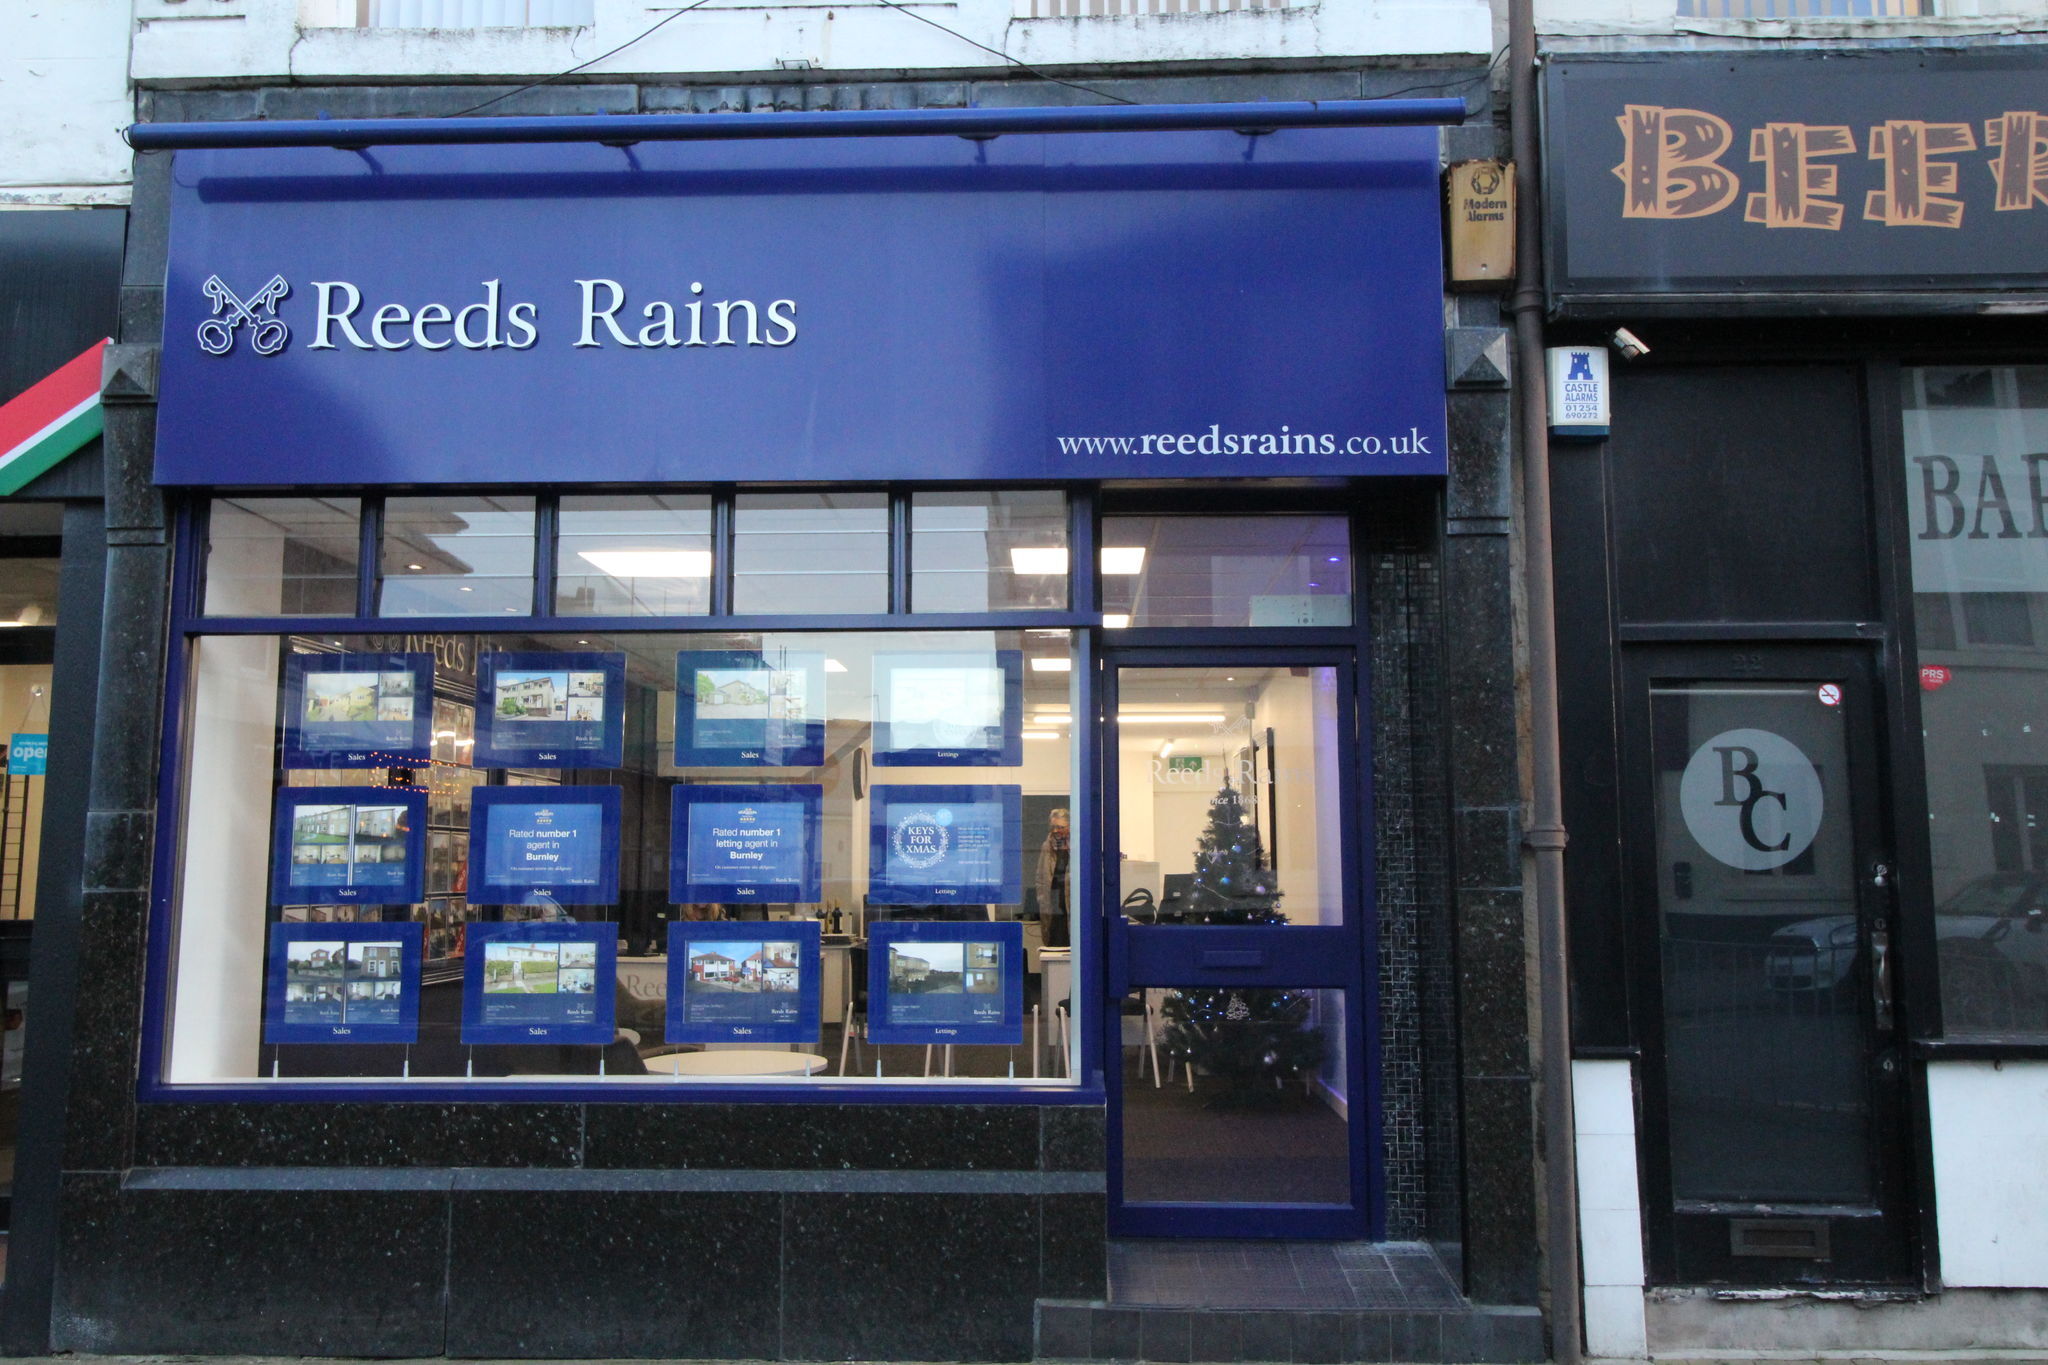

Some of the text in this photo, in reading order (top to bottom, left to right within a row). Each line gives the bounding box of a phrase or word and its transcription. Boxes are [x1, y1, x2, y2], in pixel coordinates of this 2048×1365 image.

[1611, 104, 2048, 230] BEER
[1463, 197, 1508, 210] Modern
[1467, 210, 1505, 222] Alarms
[307, 278, 798, 351] Reeds Rains
[1564, 383, 1599, 393] CASTLE
[1564, 393, 1599, 402] ALARMS
[1565, 404, 1599, 412] 01254
[1056, 424, 1432, 456] www.reedsrains.co.uk
[1921, 668, 1944, 680] PRS
[348, 753, 366, 761] Sales
[538, 752, 557, 760] Sales
[741, 751, 759, 759] Sales
[509, 829, 577, 838] Rated number 1
[712, 828, 781, 837] Rated number 1
[908, 826, 935, 835] KEYS
[716, 839, 778, 850] letting agent in
[910, 836, 933, 844] FOR
[526, 840, 560, 850] agent in
[906, 844, 937, 853] XMAS
[526, 853, 559, 862] Burnley
[730, 851, 764, 861] Burnley
[339, 889, 357, 897] Sales
[533, 888, 552, 896] Sales
[736, 887, 755, 896] Sales
[935, 888, 957, 896] Lettings
[332, 1027, 351, 1035] Sales
[529, 1027, 548, 1036] Sales
[733, 1027, 752, 1035] Sales
[935, 1028, 958, 1037] Lettings
